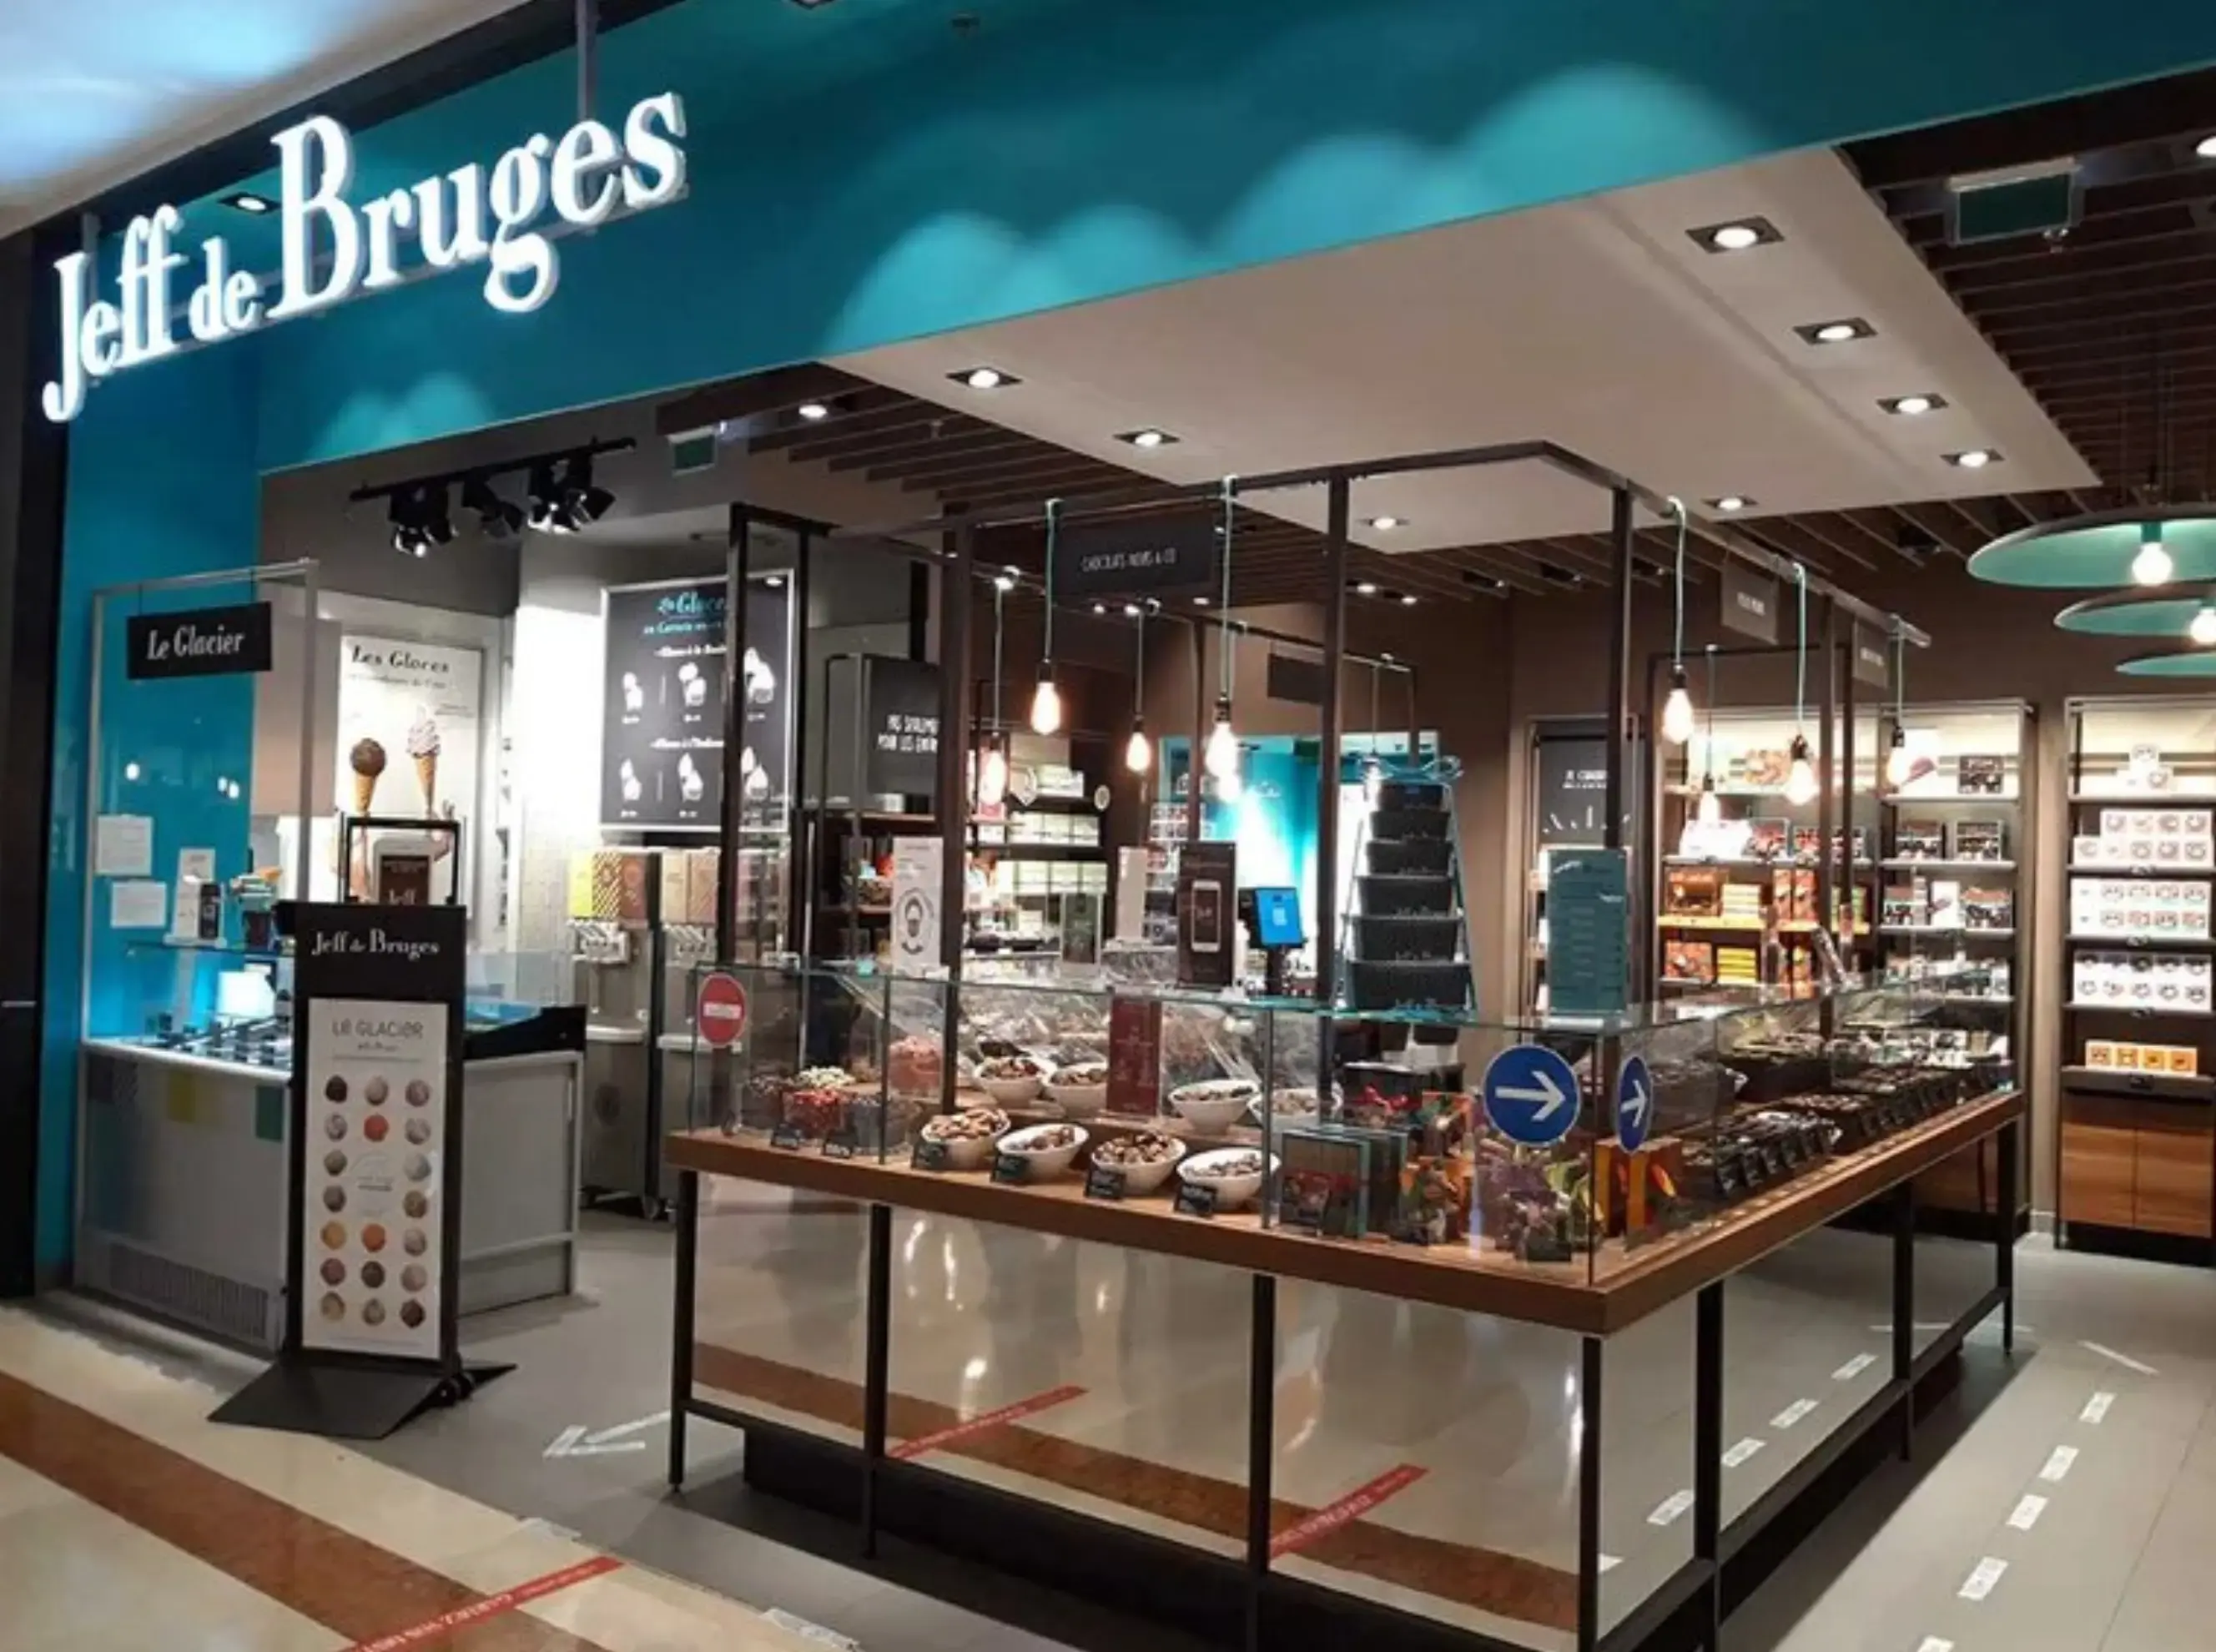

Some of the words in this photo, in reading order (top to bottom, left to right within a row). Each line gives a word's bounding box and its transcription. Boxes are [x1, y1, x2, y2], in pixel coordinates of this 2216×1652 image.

[42, 204, 189, 422] Jeff
[189, 237, 264, 342] de
[267, 92, 687, 312] Bruges
[147, 629, 169, 660] Le
[174, 625, 244, 657] Glacier
[311, 931, 350, 956] Jeff
[369, 928, 441, 961] Bruges
